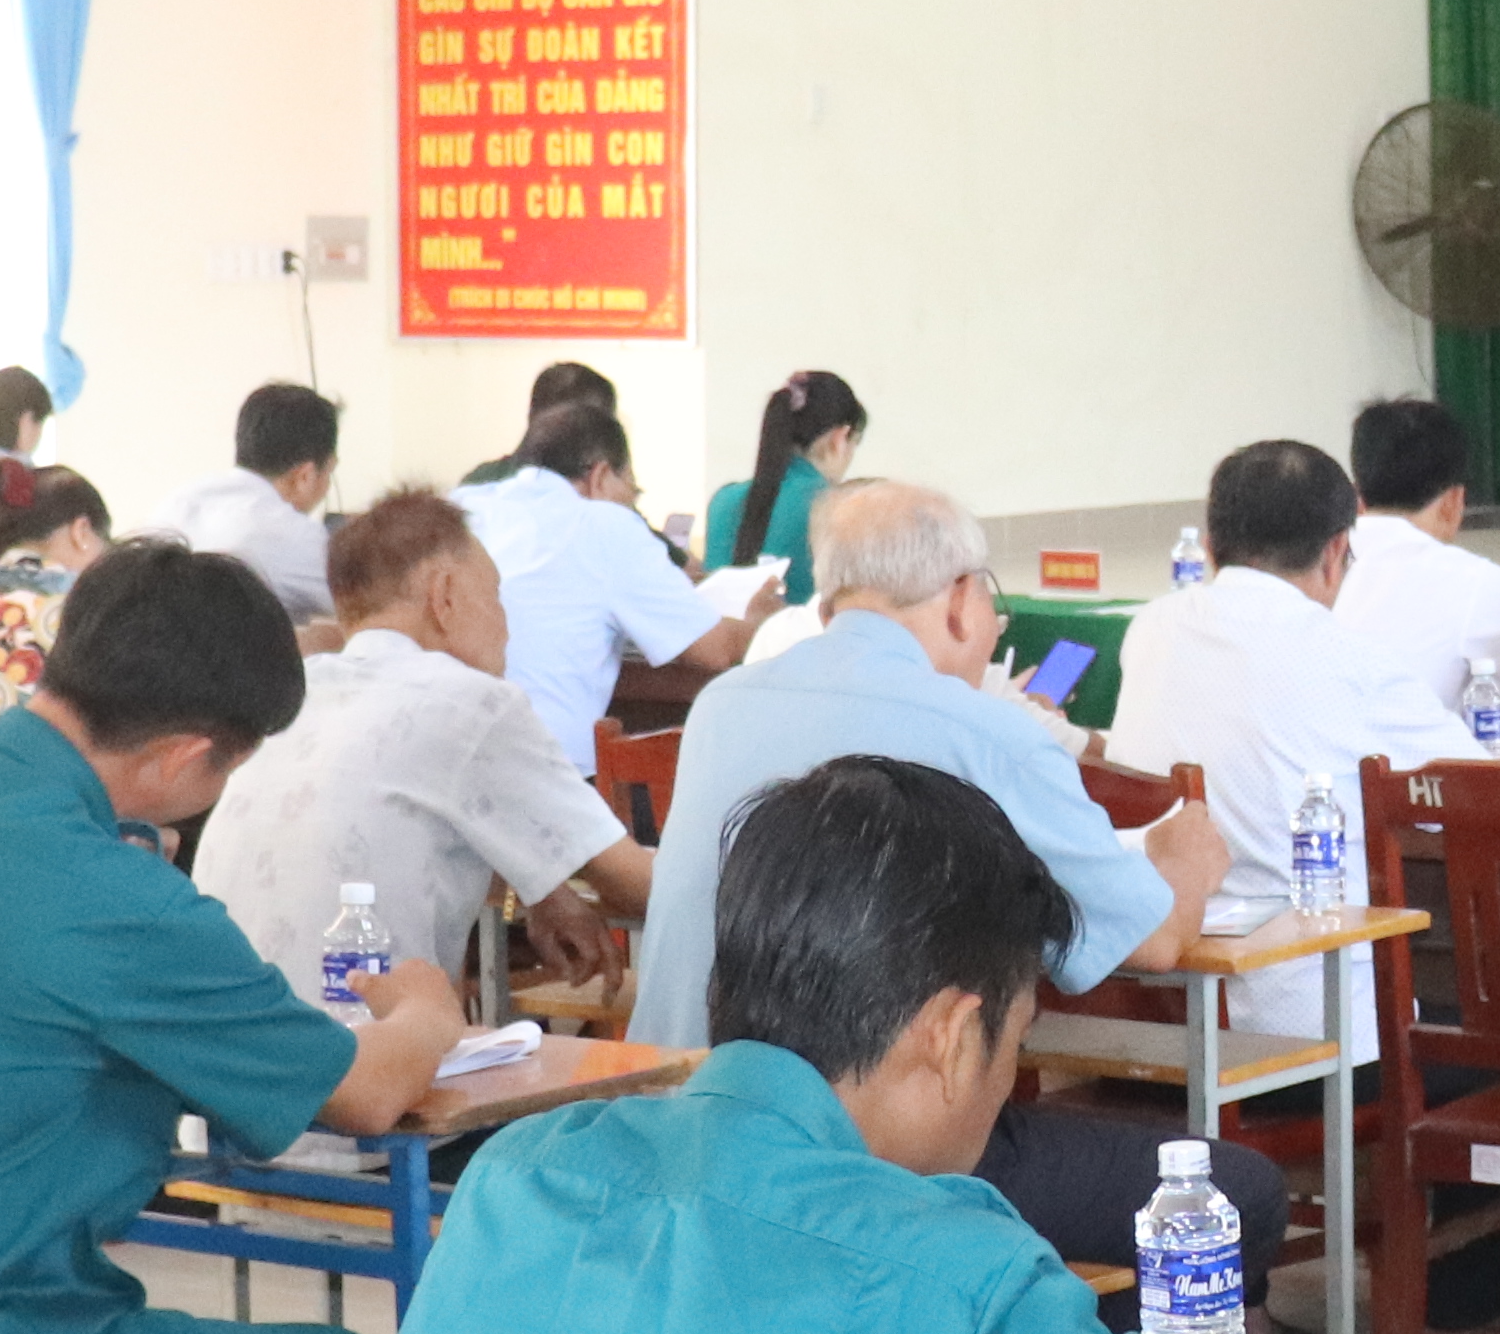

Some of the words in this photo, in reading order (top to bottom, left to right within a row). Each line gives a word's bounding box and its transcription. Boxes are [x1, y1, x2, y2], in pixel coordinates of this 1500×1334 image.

[478, 28, 515, 70] SỰ
[527, 21, 601, 62] ĐOÀN
[614, 16, 665, 60] KẾT
[419, 72, 481, 116] NHẤT
[537, 70, 586, 114] CỦA
[596, 69, 665, 113] ĐẢNG
[419, 133, 475, 167] NHƯ
[487, 127, 534, 166] GIỮ
[607, 131, 665, 166] CON
[526, 173, 586, 219] CỦA
[1409, 777, 1443, 808] HT
